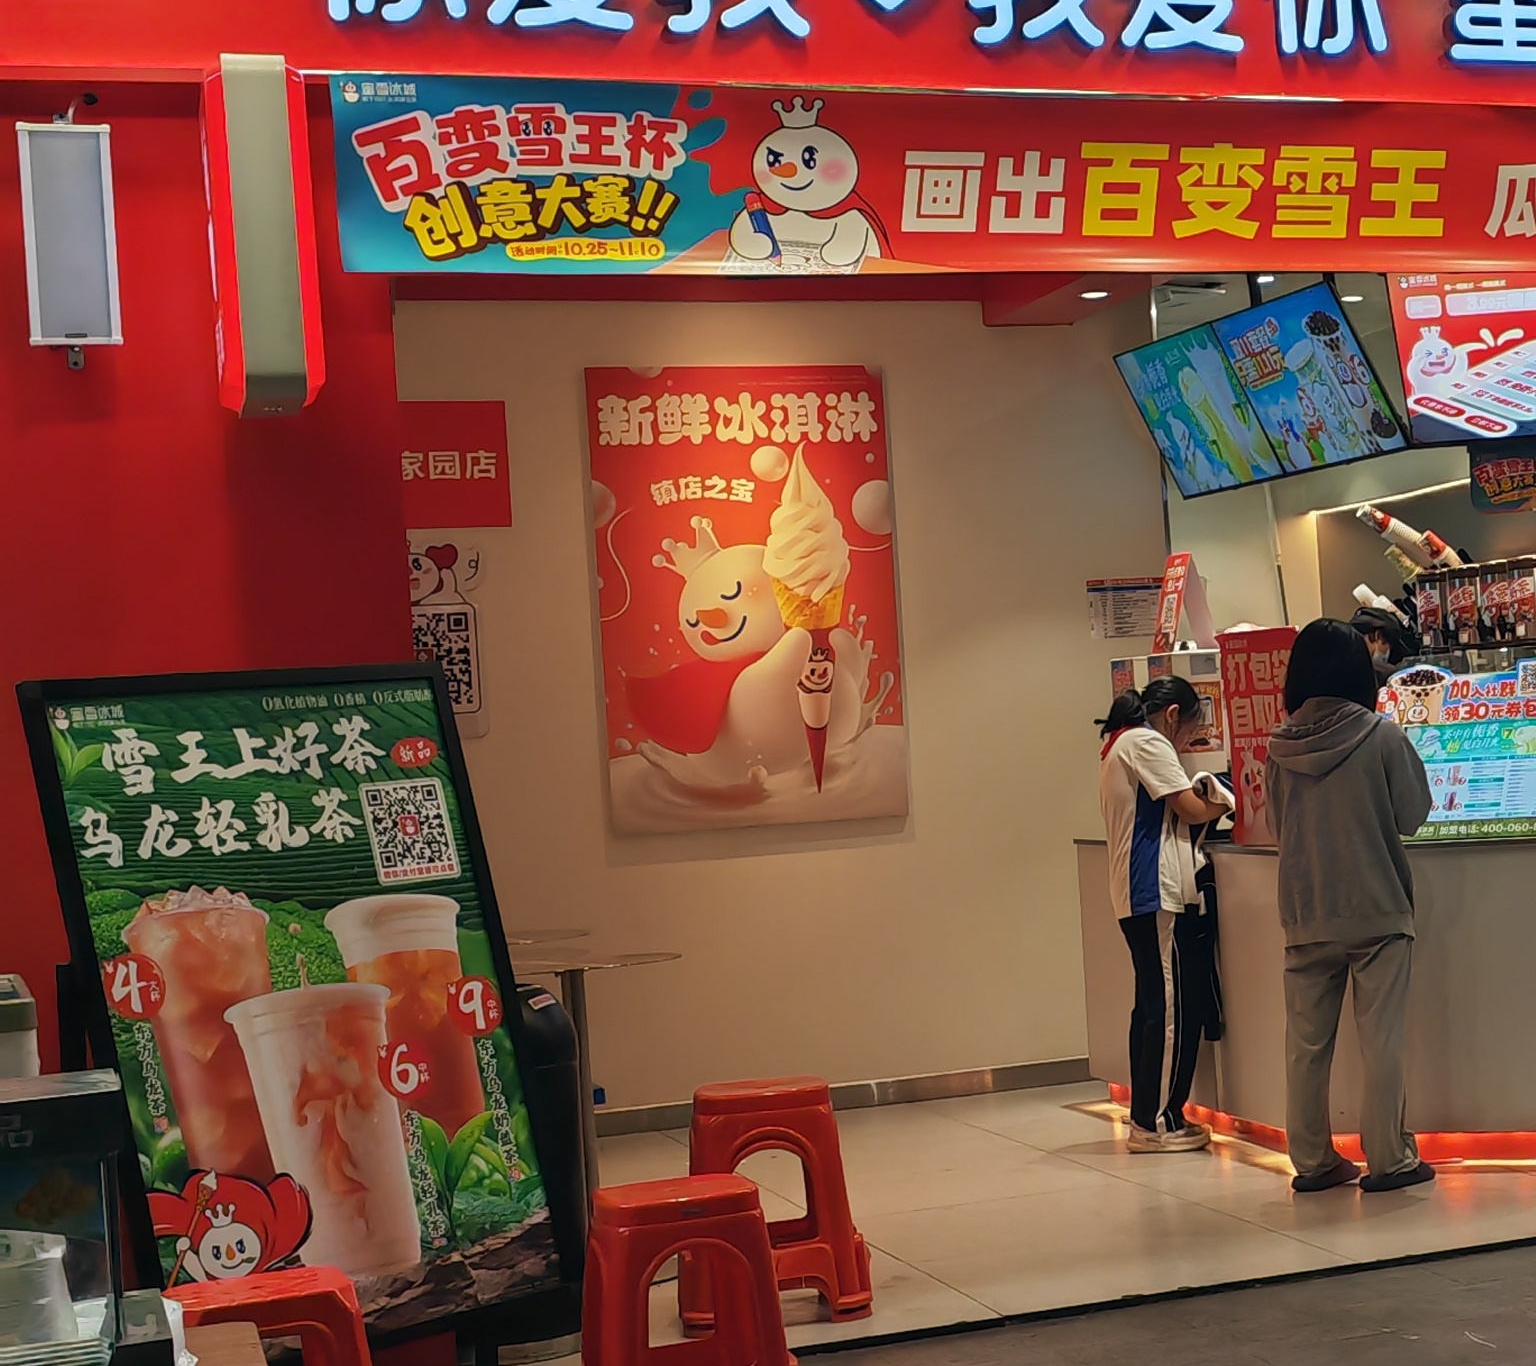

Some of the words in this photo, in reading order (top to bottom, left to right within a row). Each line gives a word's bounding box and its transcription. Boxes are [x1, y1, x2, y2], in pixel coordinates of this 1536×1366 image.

[354, 106, 678, 203] 百变雪王杯
[597, 390, 878, 446] 新鲜冰淇淋
[650, 475, 755, 506] 镇店之宝
[1448, 679, 1517, 701] 加入社群
[102, 715, 387, 797] 雪王上好茶
[398, 740, 433, 766] 新品
[79, 787, 364, 868] 乌龙轻乳茶
[133, 1021, 167, 1116] 东方乌龙茶
[404, 1108, 447, 1238] 东方乌龙轻乳茶
